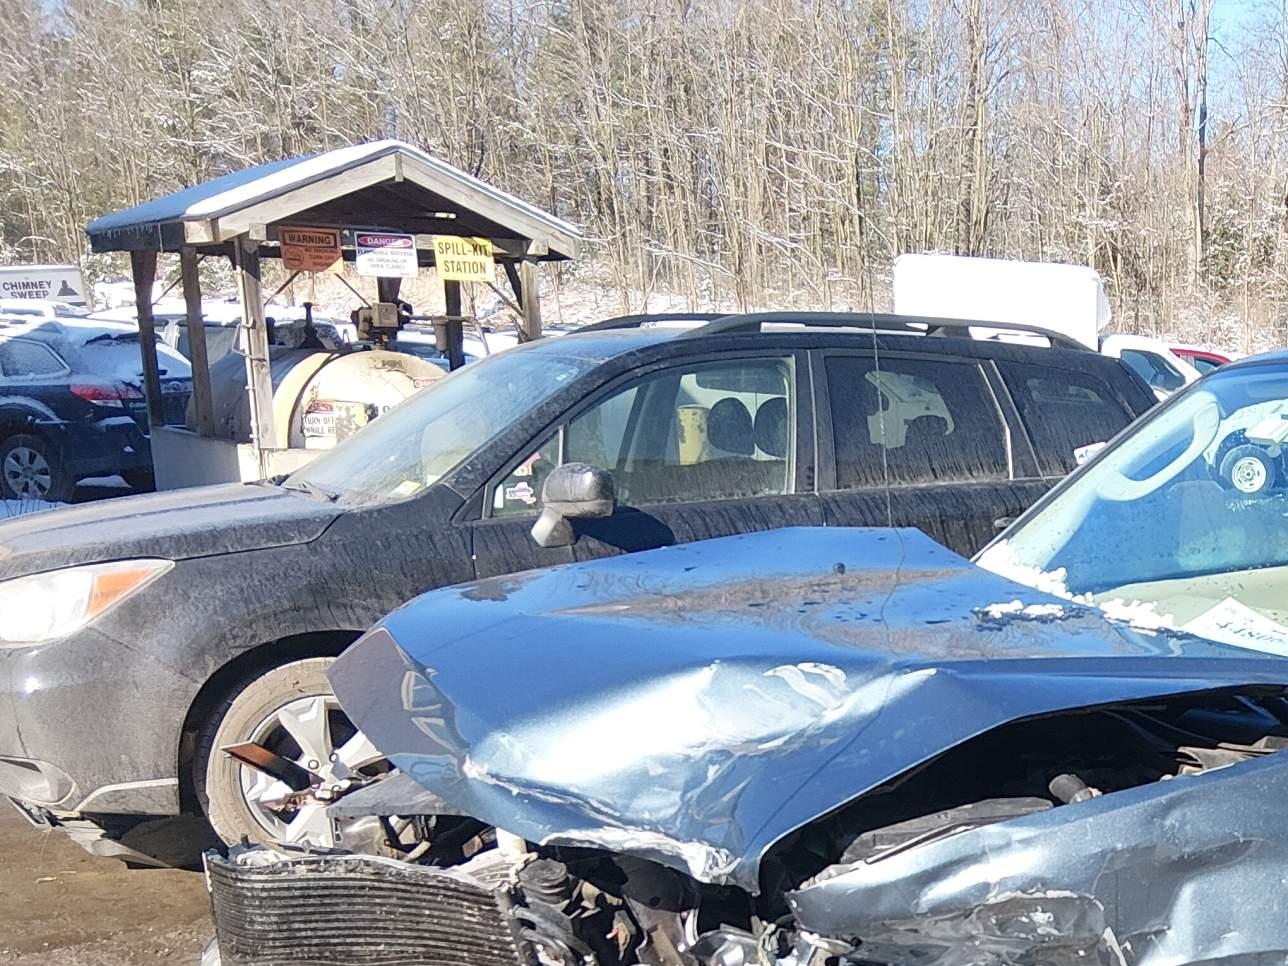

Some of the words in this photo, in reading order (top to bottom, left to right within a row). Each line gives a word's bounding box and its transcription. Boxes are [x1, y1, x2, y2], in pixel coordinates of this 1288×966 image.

[288, 234, 331, 245] WARNING
[438, 242, 488, 257] SPILL-KIT
[444, 260, 487, 274] STATION
[2, 280, 52, 291] CHIMNEY
[10, 290, 49, 299] SWEEP
